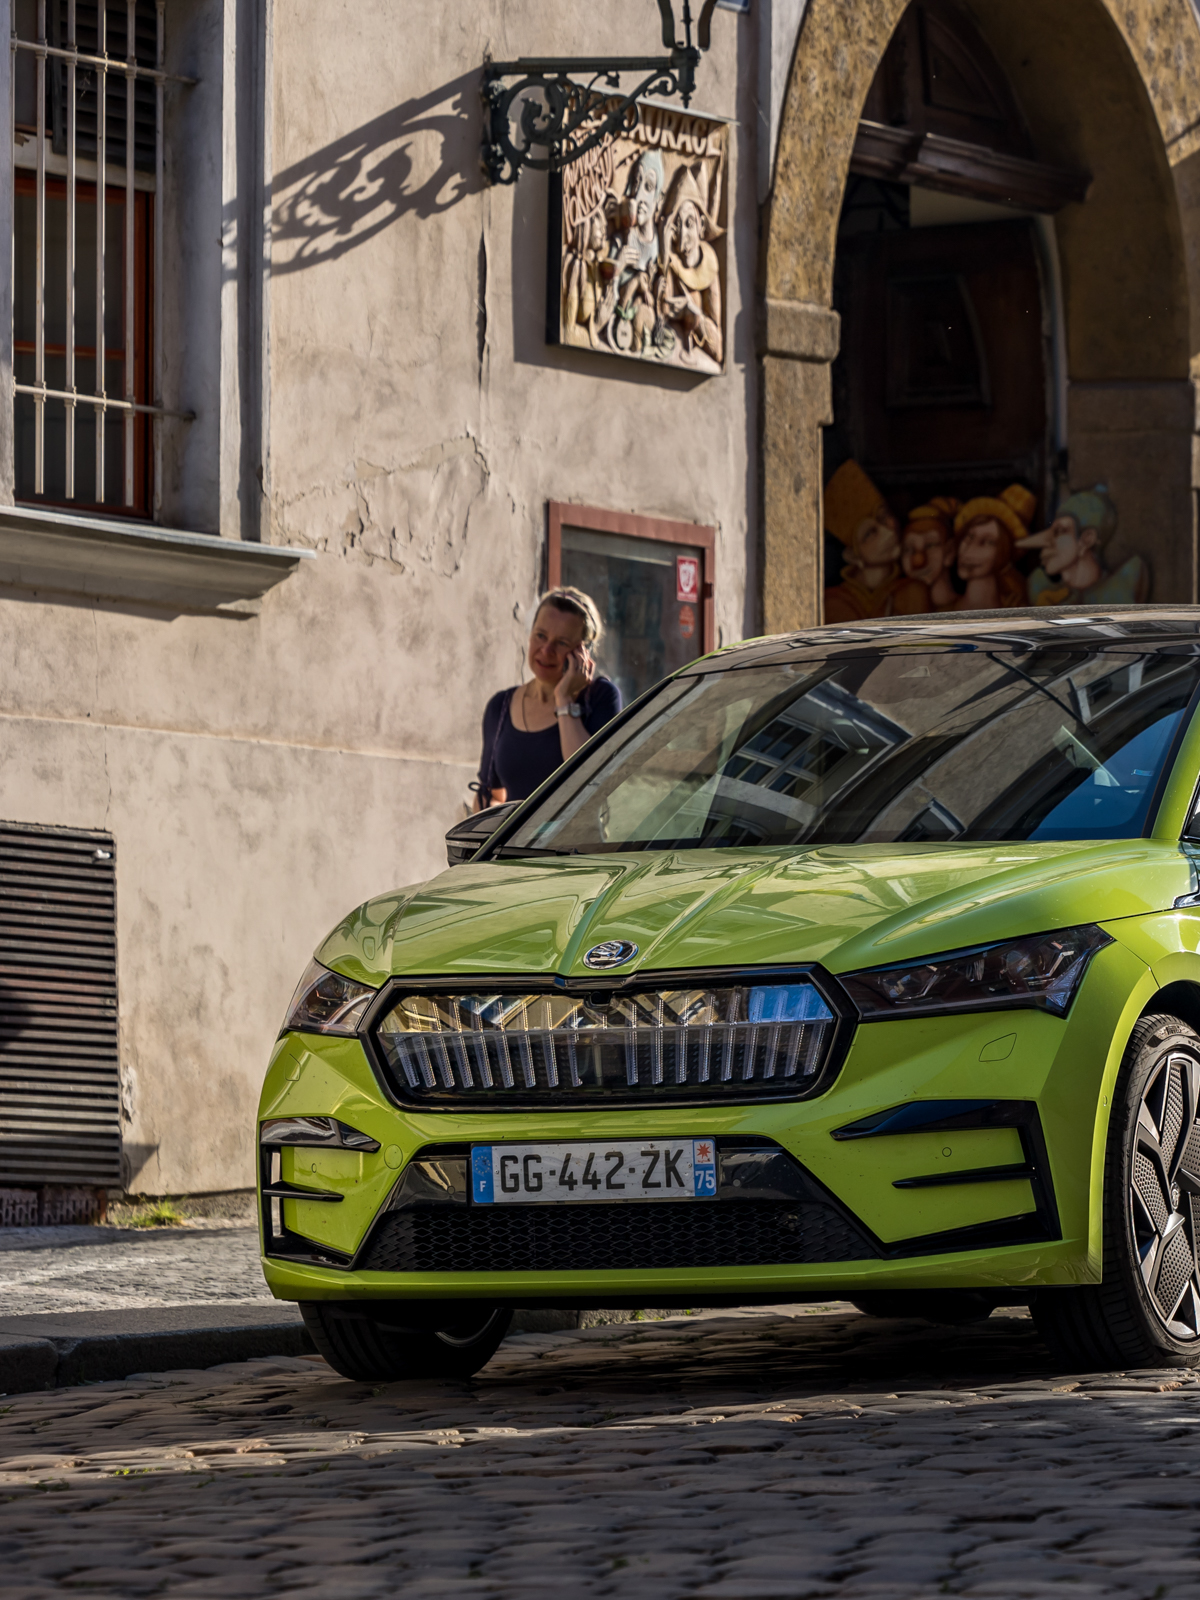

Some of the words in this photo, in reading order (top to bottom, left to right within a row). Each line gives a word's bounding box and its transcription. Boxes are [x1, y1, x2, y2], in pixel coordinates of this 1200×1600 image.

[499, 1148, 686, 1193] GG-442-ZK
[695, 1170, 715, 1190] 75
[479, 1180, 487, 1193] F
